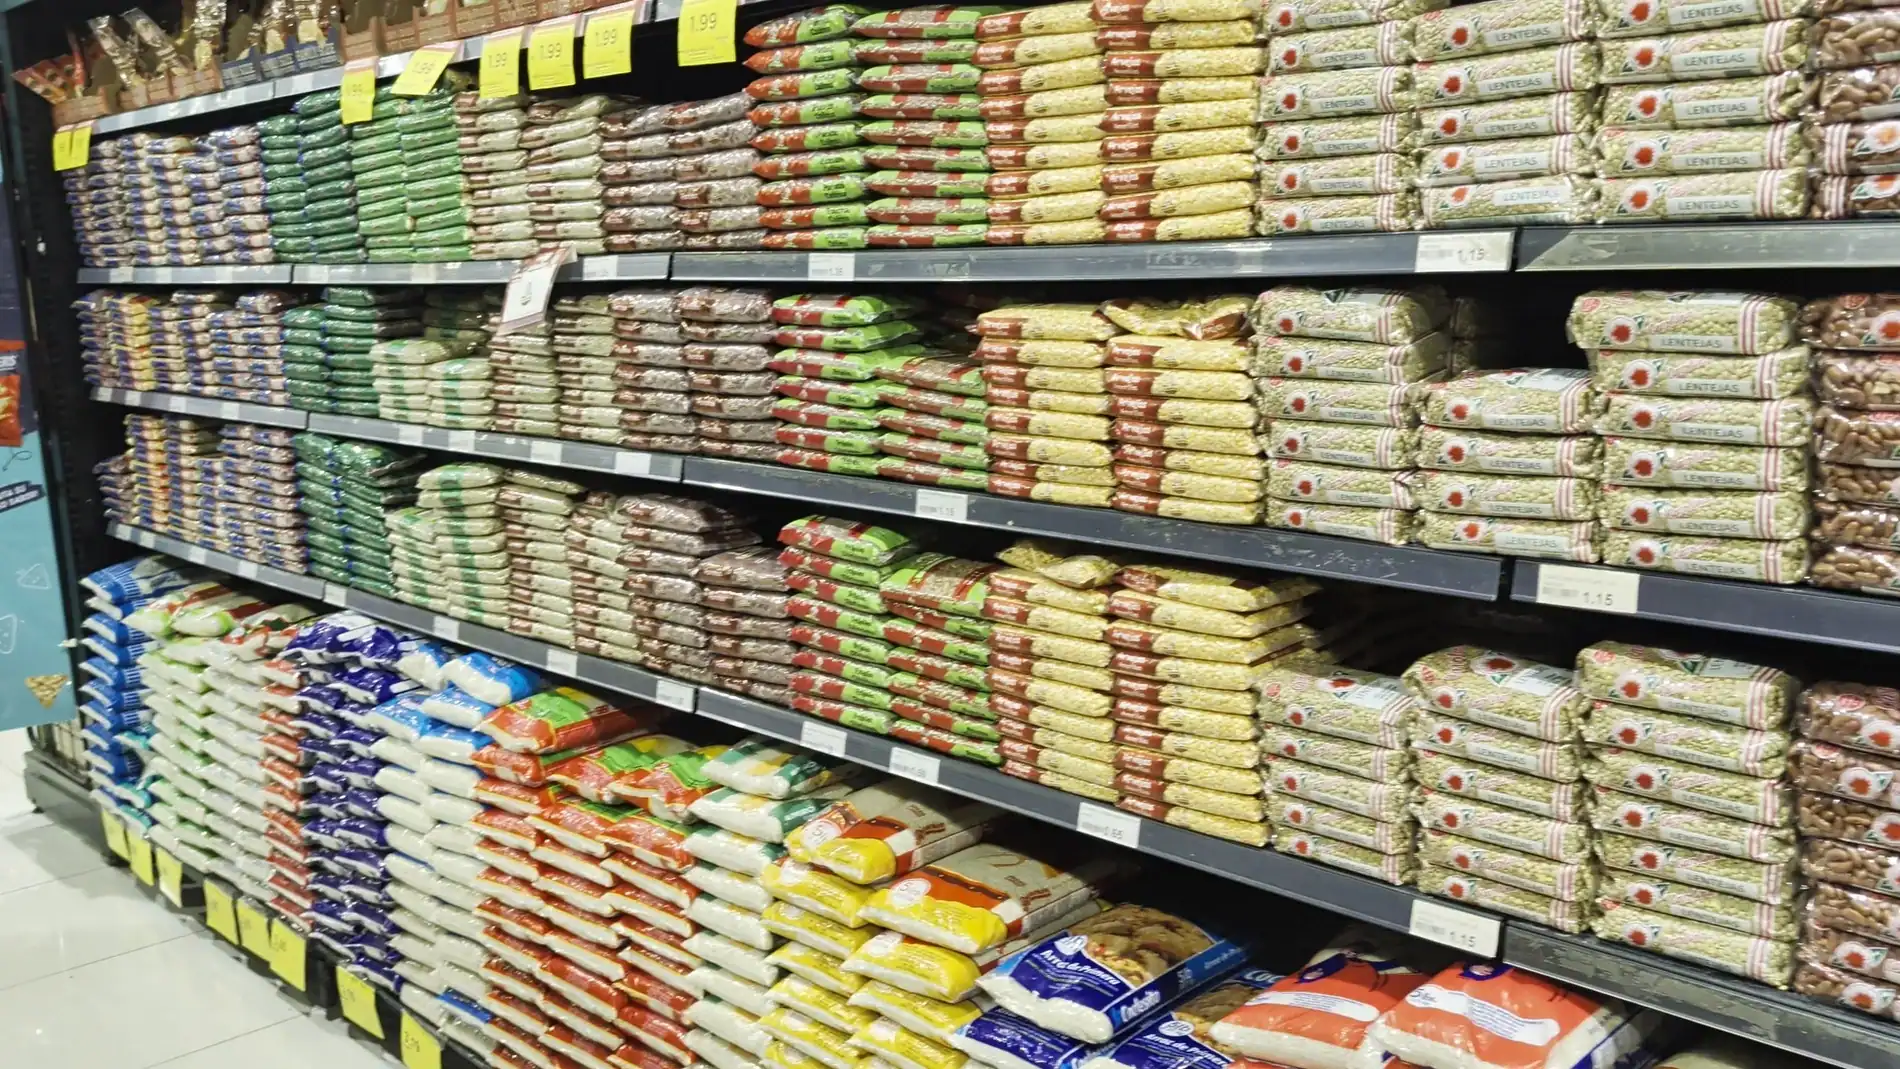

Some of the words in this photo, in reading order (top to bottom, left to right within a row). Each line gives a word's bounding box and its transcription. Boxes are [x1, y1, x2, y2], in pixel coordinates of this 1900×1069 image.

[1680, 3, 1744, 20] LENTEJAS
[690, 13, 718, 32] 1.99
[595, 29, 617, 46] 1.99
[1495, 27, 1550, 42] LENTEJAS
[539, 43, 561, 60] 1.99
[1683, 53, 1746, 67] LENTEJAS
[1488, 77, 1542, 91] LENTEJAS
[1687, 102, 1747, 116] LENTEJAS
[1484, 122, 1538, 134] LENTEJAS
[1484, 156, 1538, 169] LENTEJAS
[1685, 156, 1748, 167] LENTEJAS
[1677, 200, 1740, 211] LENTEJAS
[1660, 338, 1722, 349] LENTEJAS
[1679, 381, 1740, 393] LENTEJAS
[1681, 426, 1744, 439] LENTEJAS
[1683, 474, 1744, 485] LENTEJAS
[1583, 592, 1613, 606] 1.15
[1186, 1047, 1229, 1067] Primer
